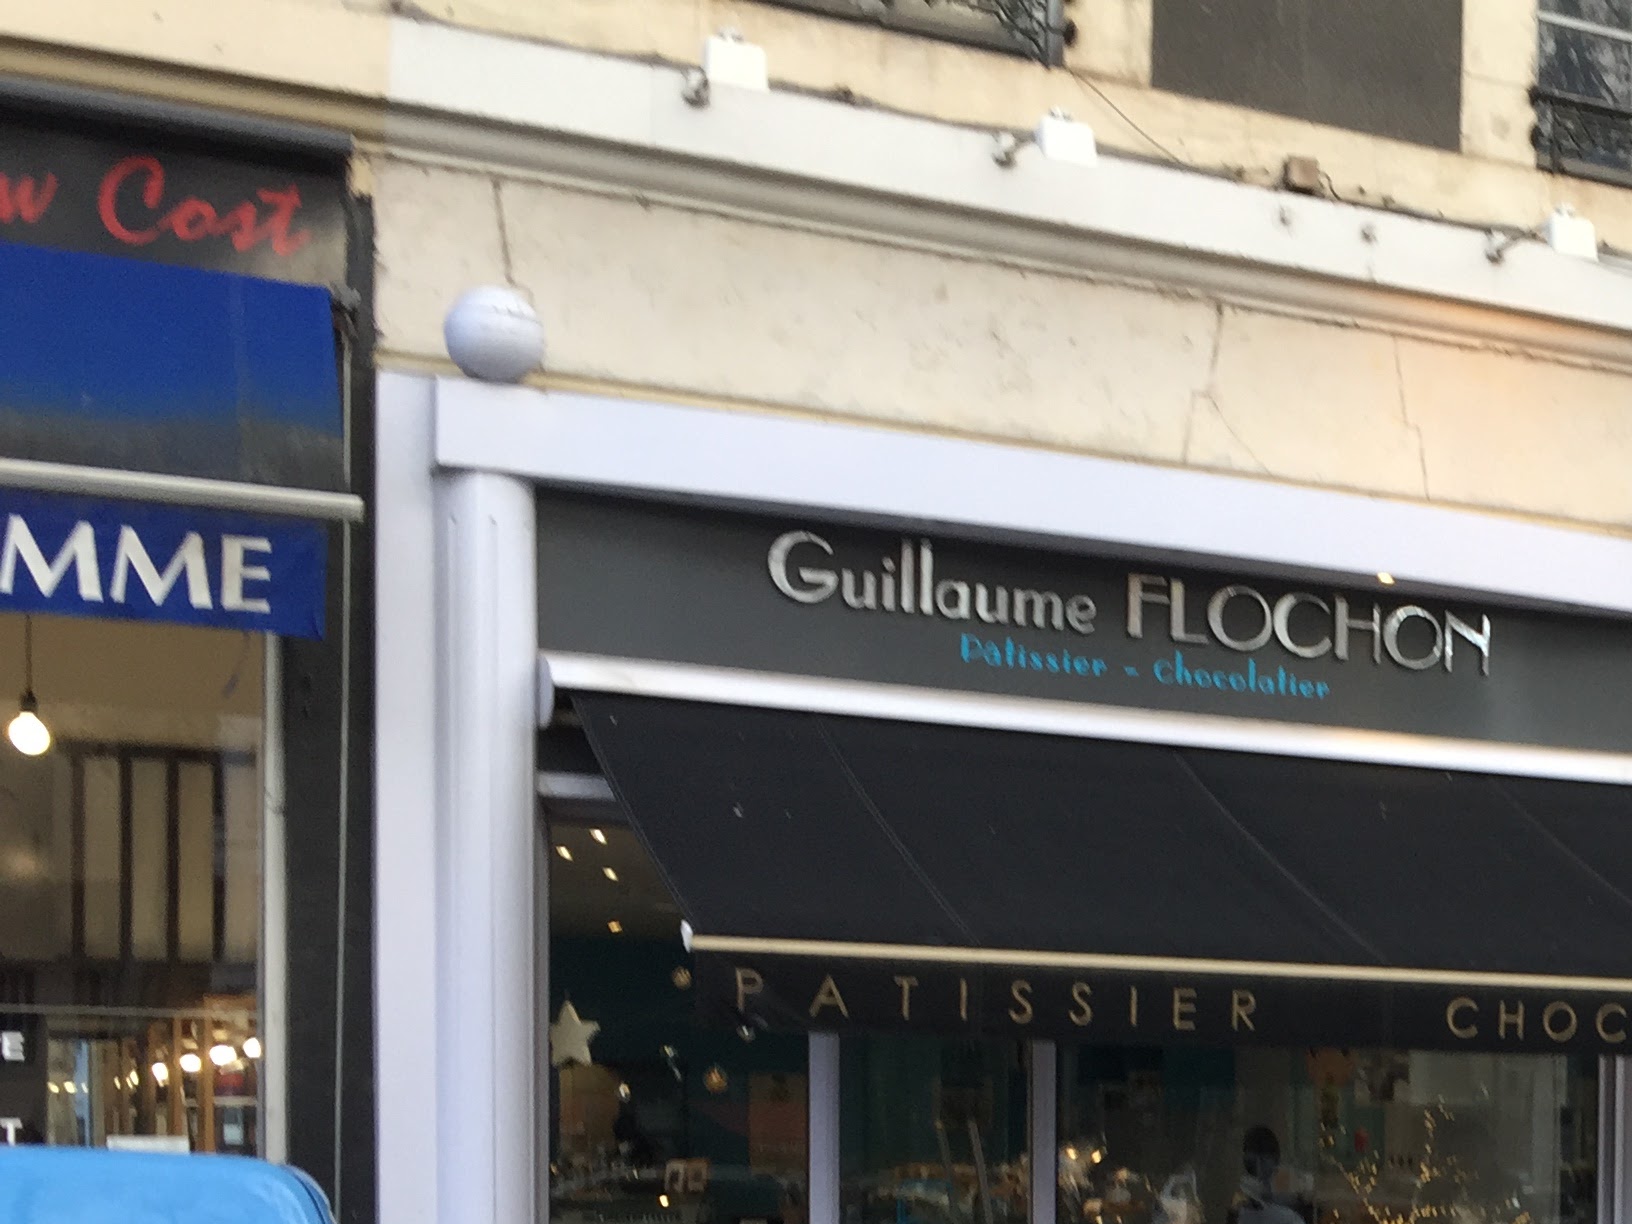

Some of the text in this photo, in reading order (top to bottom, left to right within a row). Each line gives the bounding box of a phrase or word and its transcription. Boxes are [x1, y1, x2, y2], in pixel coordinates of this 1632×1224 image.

[97, 156, 312, 256] Cost
[766, 530, 1493, 677] Guillaume FLOCHON
[1152, 650, 1331, 701] Chocolatier
[735, 966, 1257, 1032] PATISSIER
